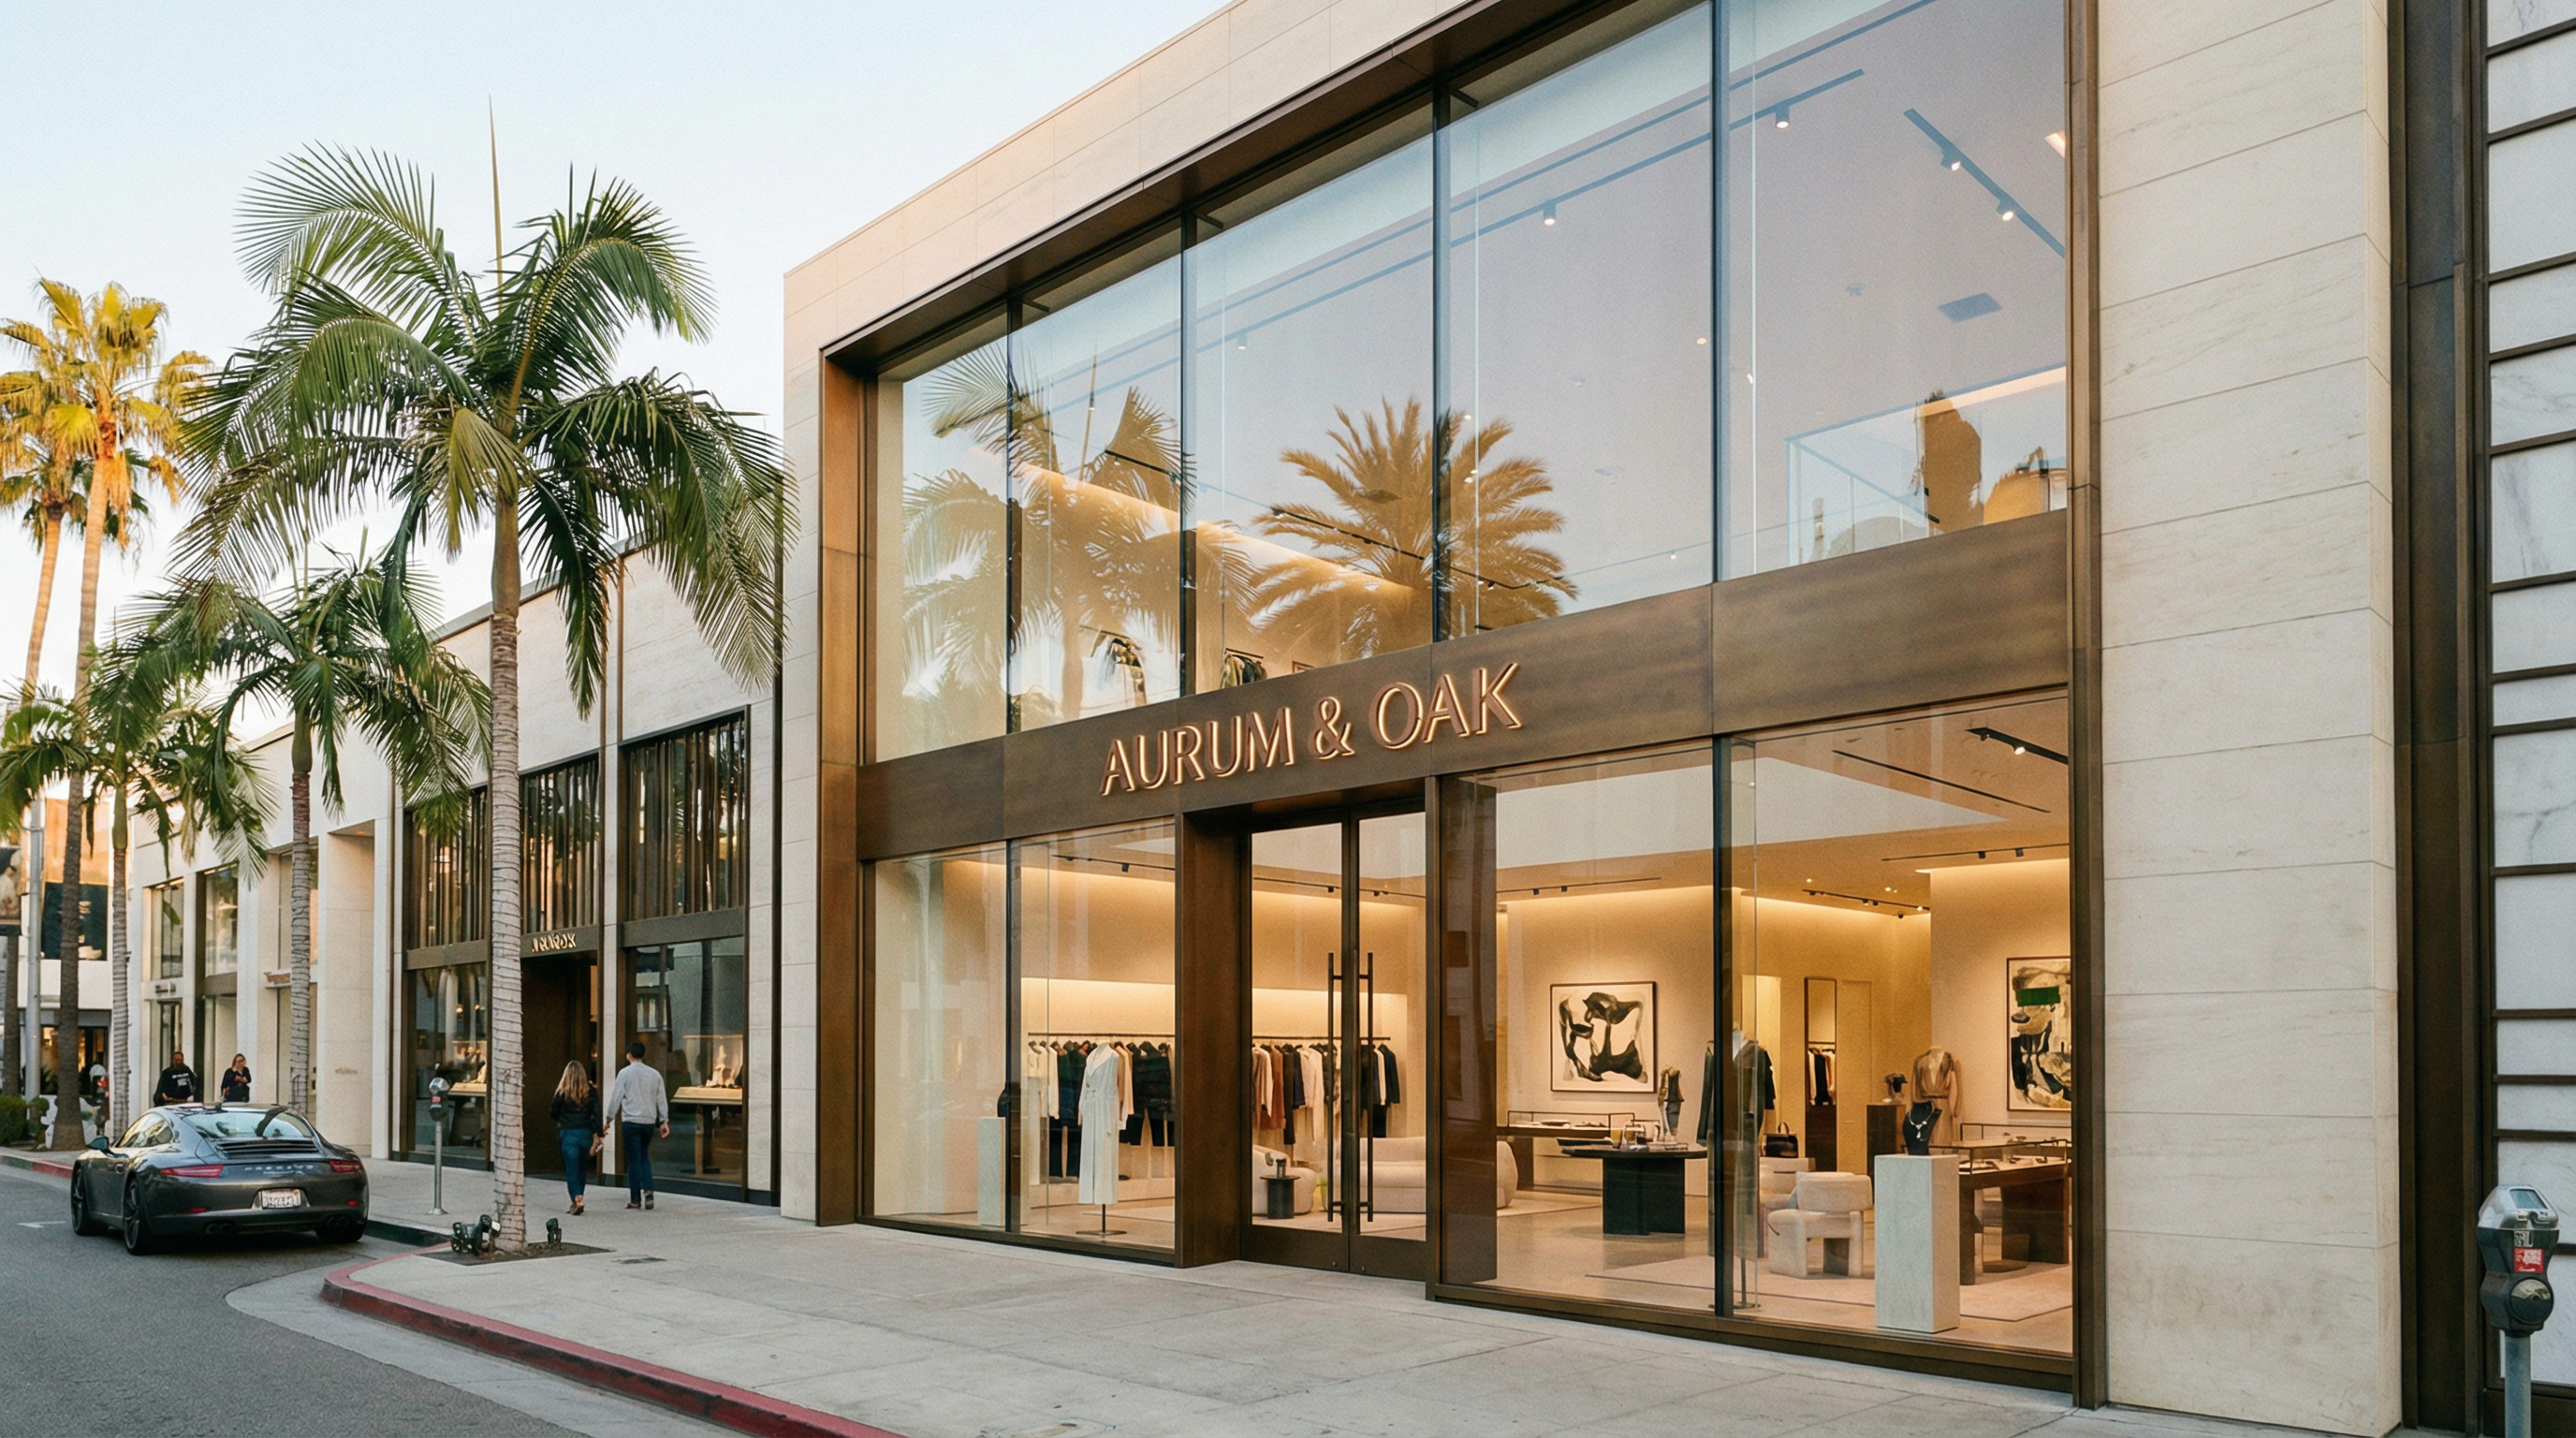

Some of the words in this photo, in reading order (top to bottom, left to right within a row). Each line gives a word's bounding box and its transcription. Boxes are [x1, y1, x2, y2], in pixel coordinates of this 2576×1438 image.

[1099, 706, 1295, 796] AURUM
[1313, 696, 1355, 760] &
[1368, 663, 1523, 749] OAK
